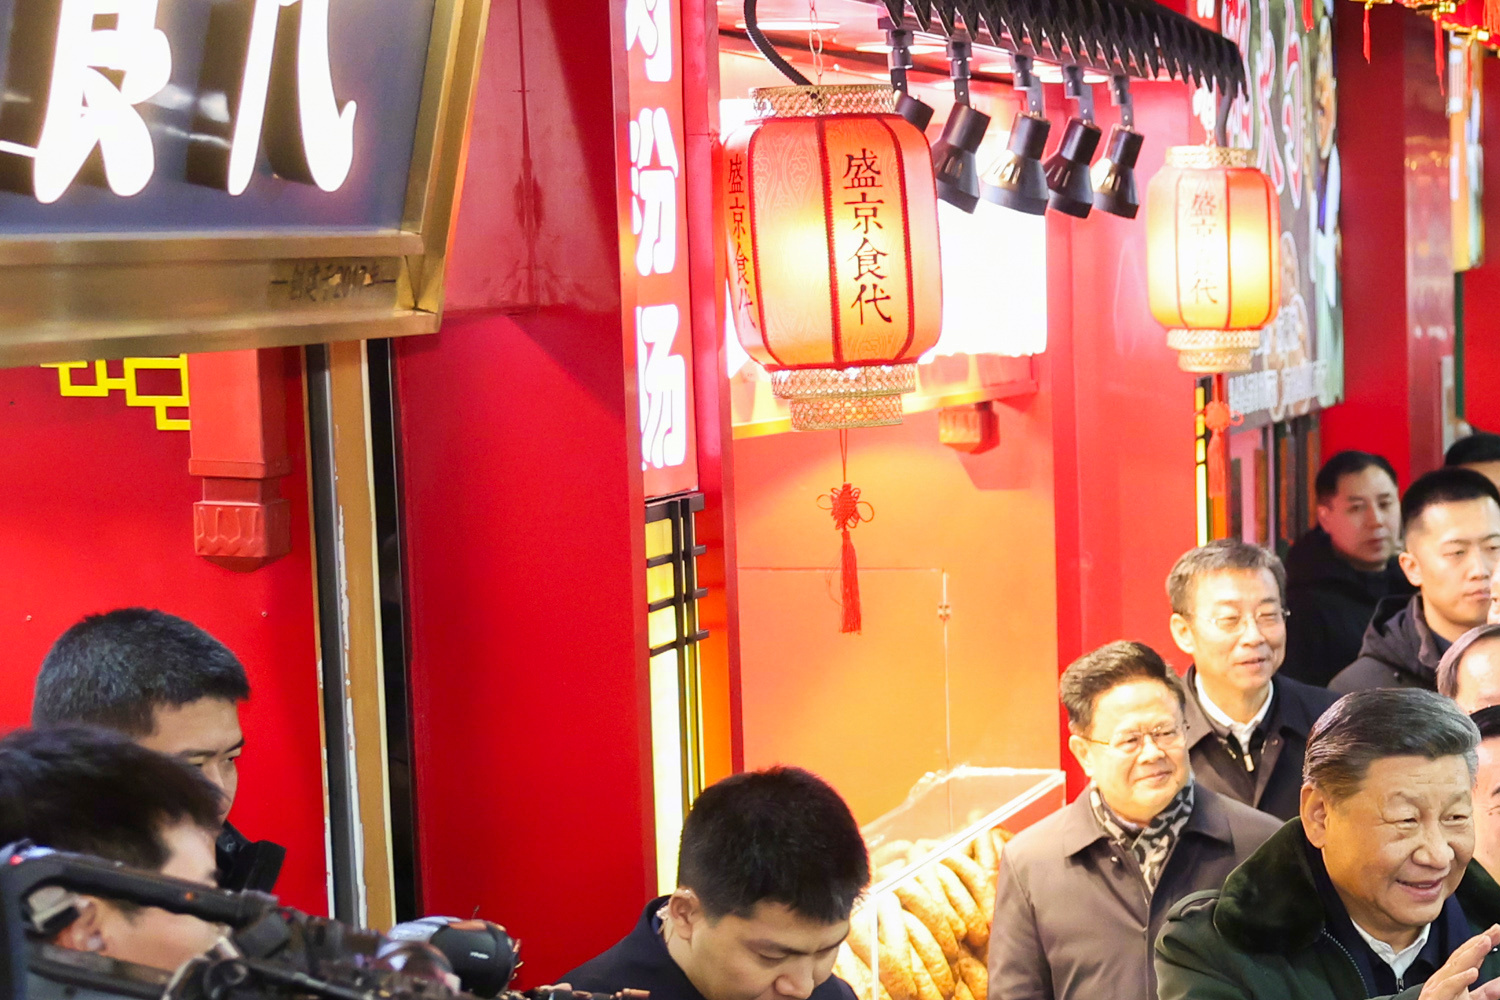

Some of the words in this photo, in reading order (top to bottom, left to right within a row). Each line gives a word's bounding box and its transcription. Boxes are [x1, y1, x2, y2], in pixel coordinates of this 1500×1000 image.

[728, 153, 757, 329] 盛京食代
[843, 148, 893, 326] 盛京食代
